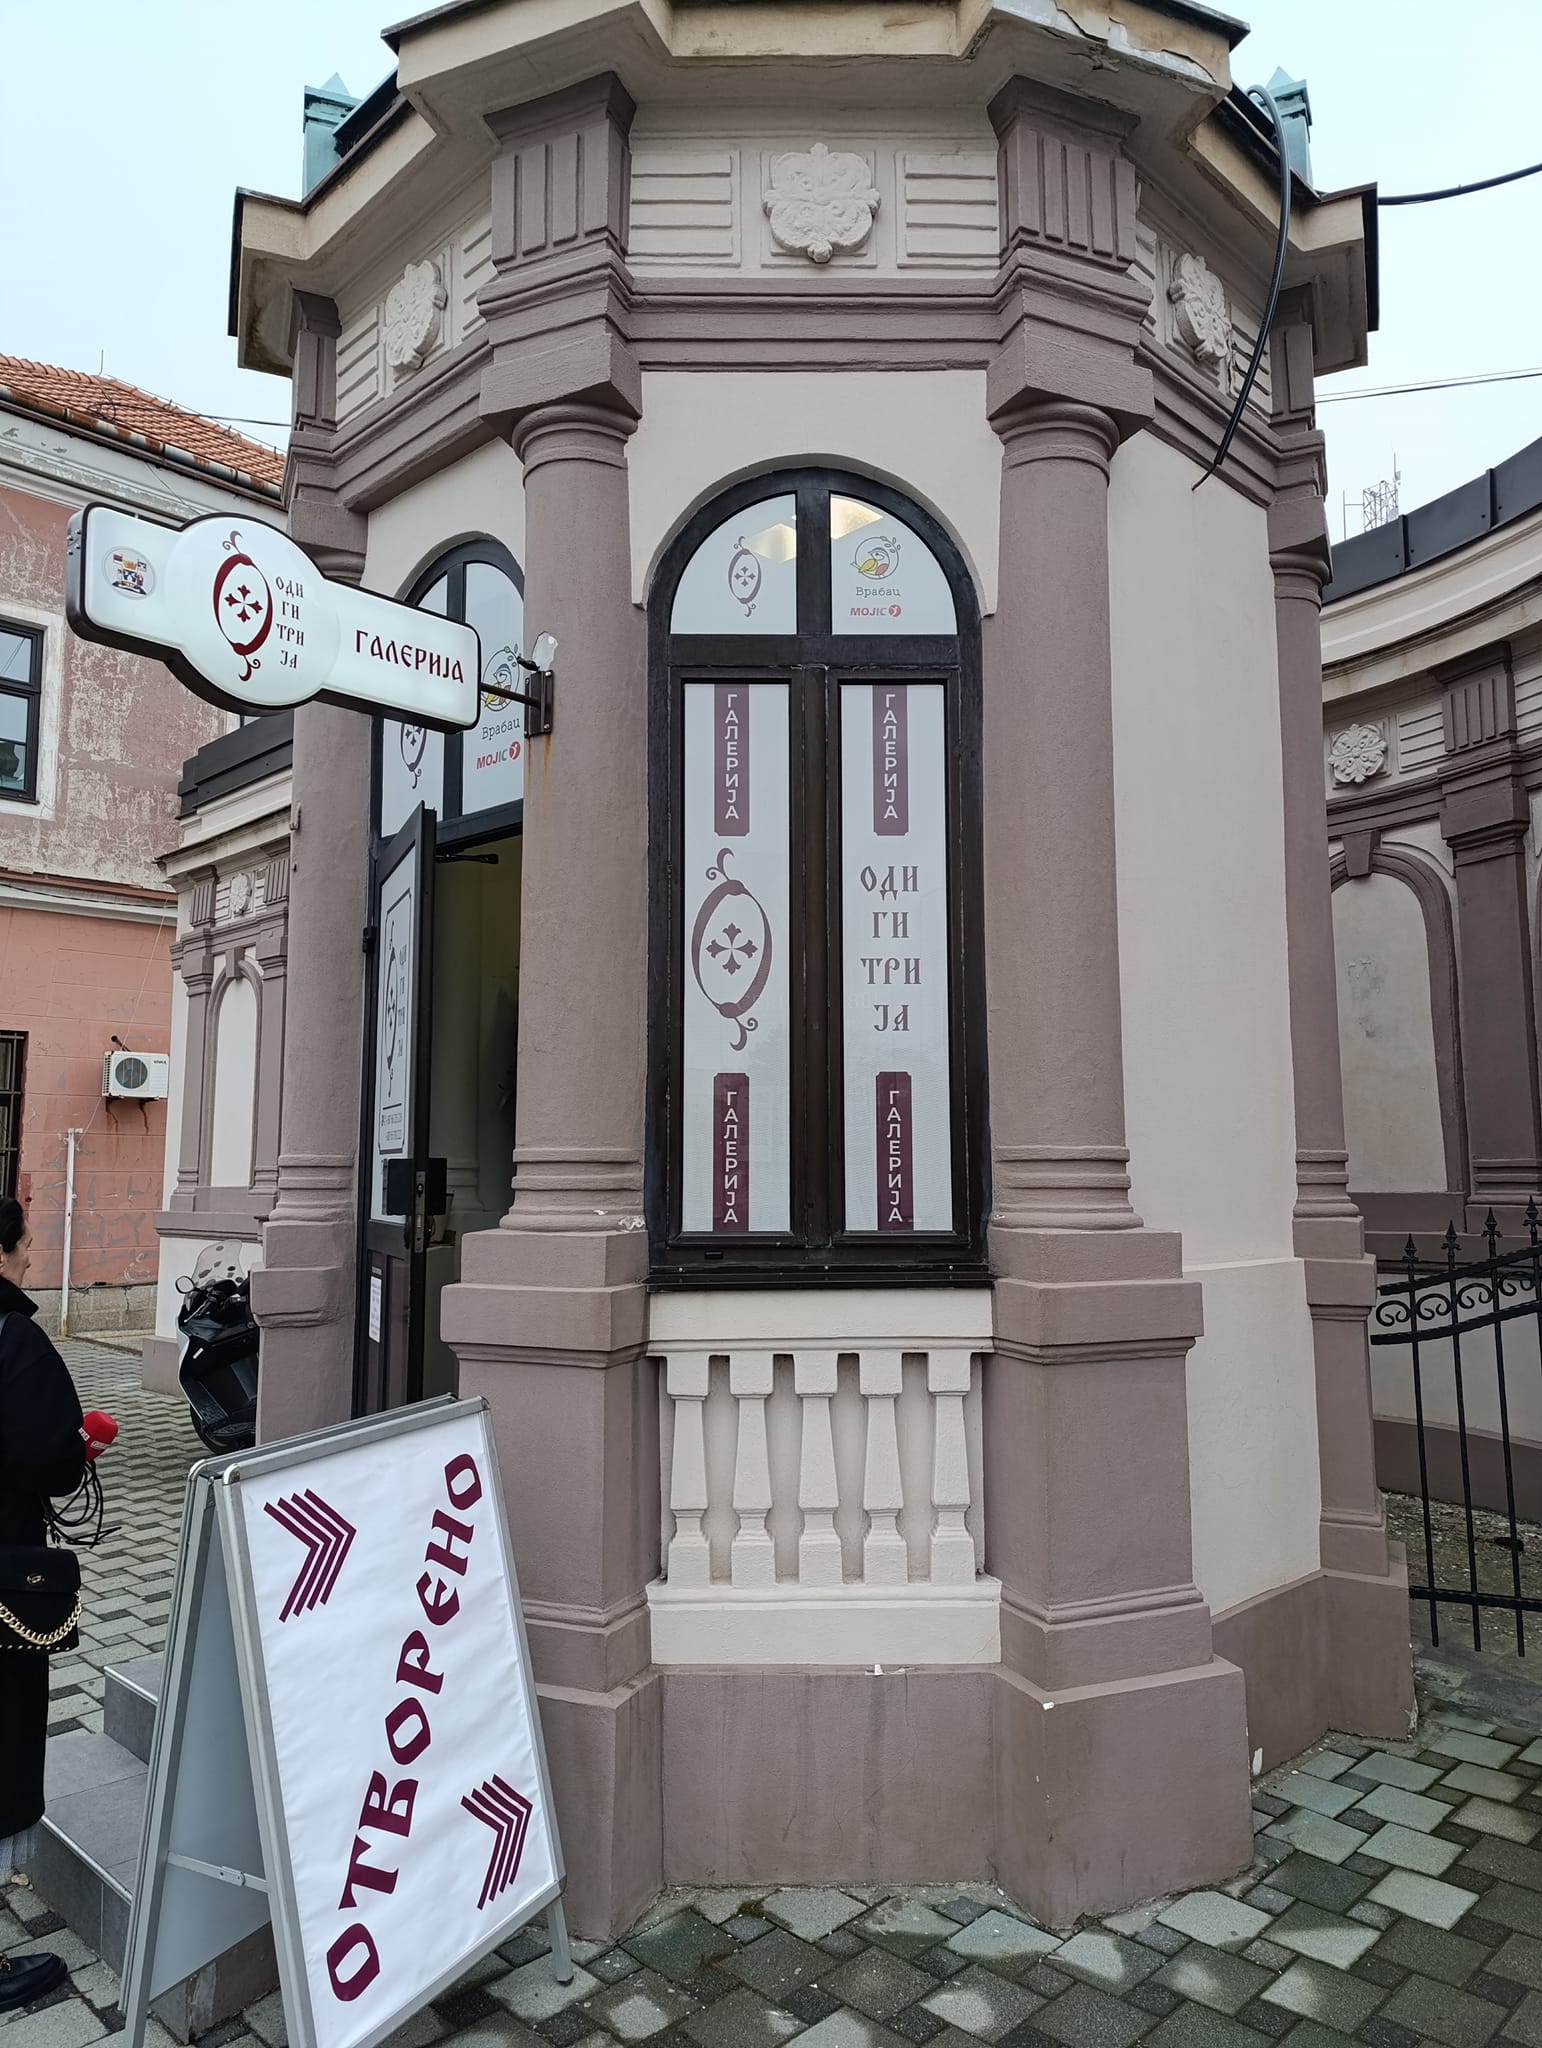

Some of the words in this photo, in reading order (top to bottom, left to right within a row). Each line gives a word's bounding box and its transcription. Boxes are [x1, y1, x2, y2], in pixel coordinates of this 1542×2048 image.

[276, 576, 304, 598] ОДИ
[856, 586, 901, 598] Врабац
[282, 601, 299, 620] ГИ
[276, 623, 304, 646] ТРИ
[356, 629, 464, 684] ГАЛЕРИЈА
[481, 718, 520, 740] Врабац
[724, 693, 740, 820] ГАЛЕРИЈА
[883, 693, 899, 820] ГАЛЕРИЈА
[860, 865, 919, 901] ОДИ
[872, 911, 909, 938] ГИ
[860, 957, 922, 985] ТРИ
[873, 1004, 910, 1032] ЈА
[723, 1091, 739, 1223] ГАЛЕРИЈА
[886, 1090, 903, 1222] ГАЛЕРИЈА
[326, 1453, 483, 2002] ОТВОРЕНО
